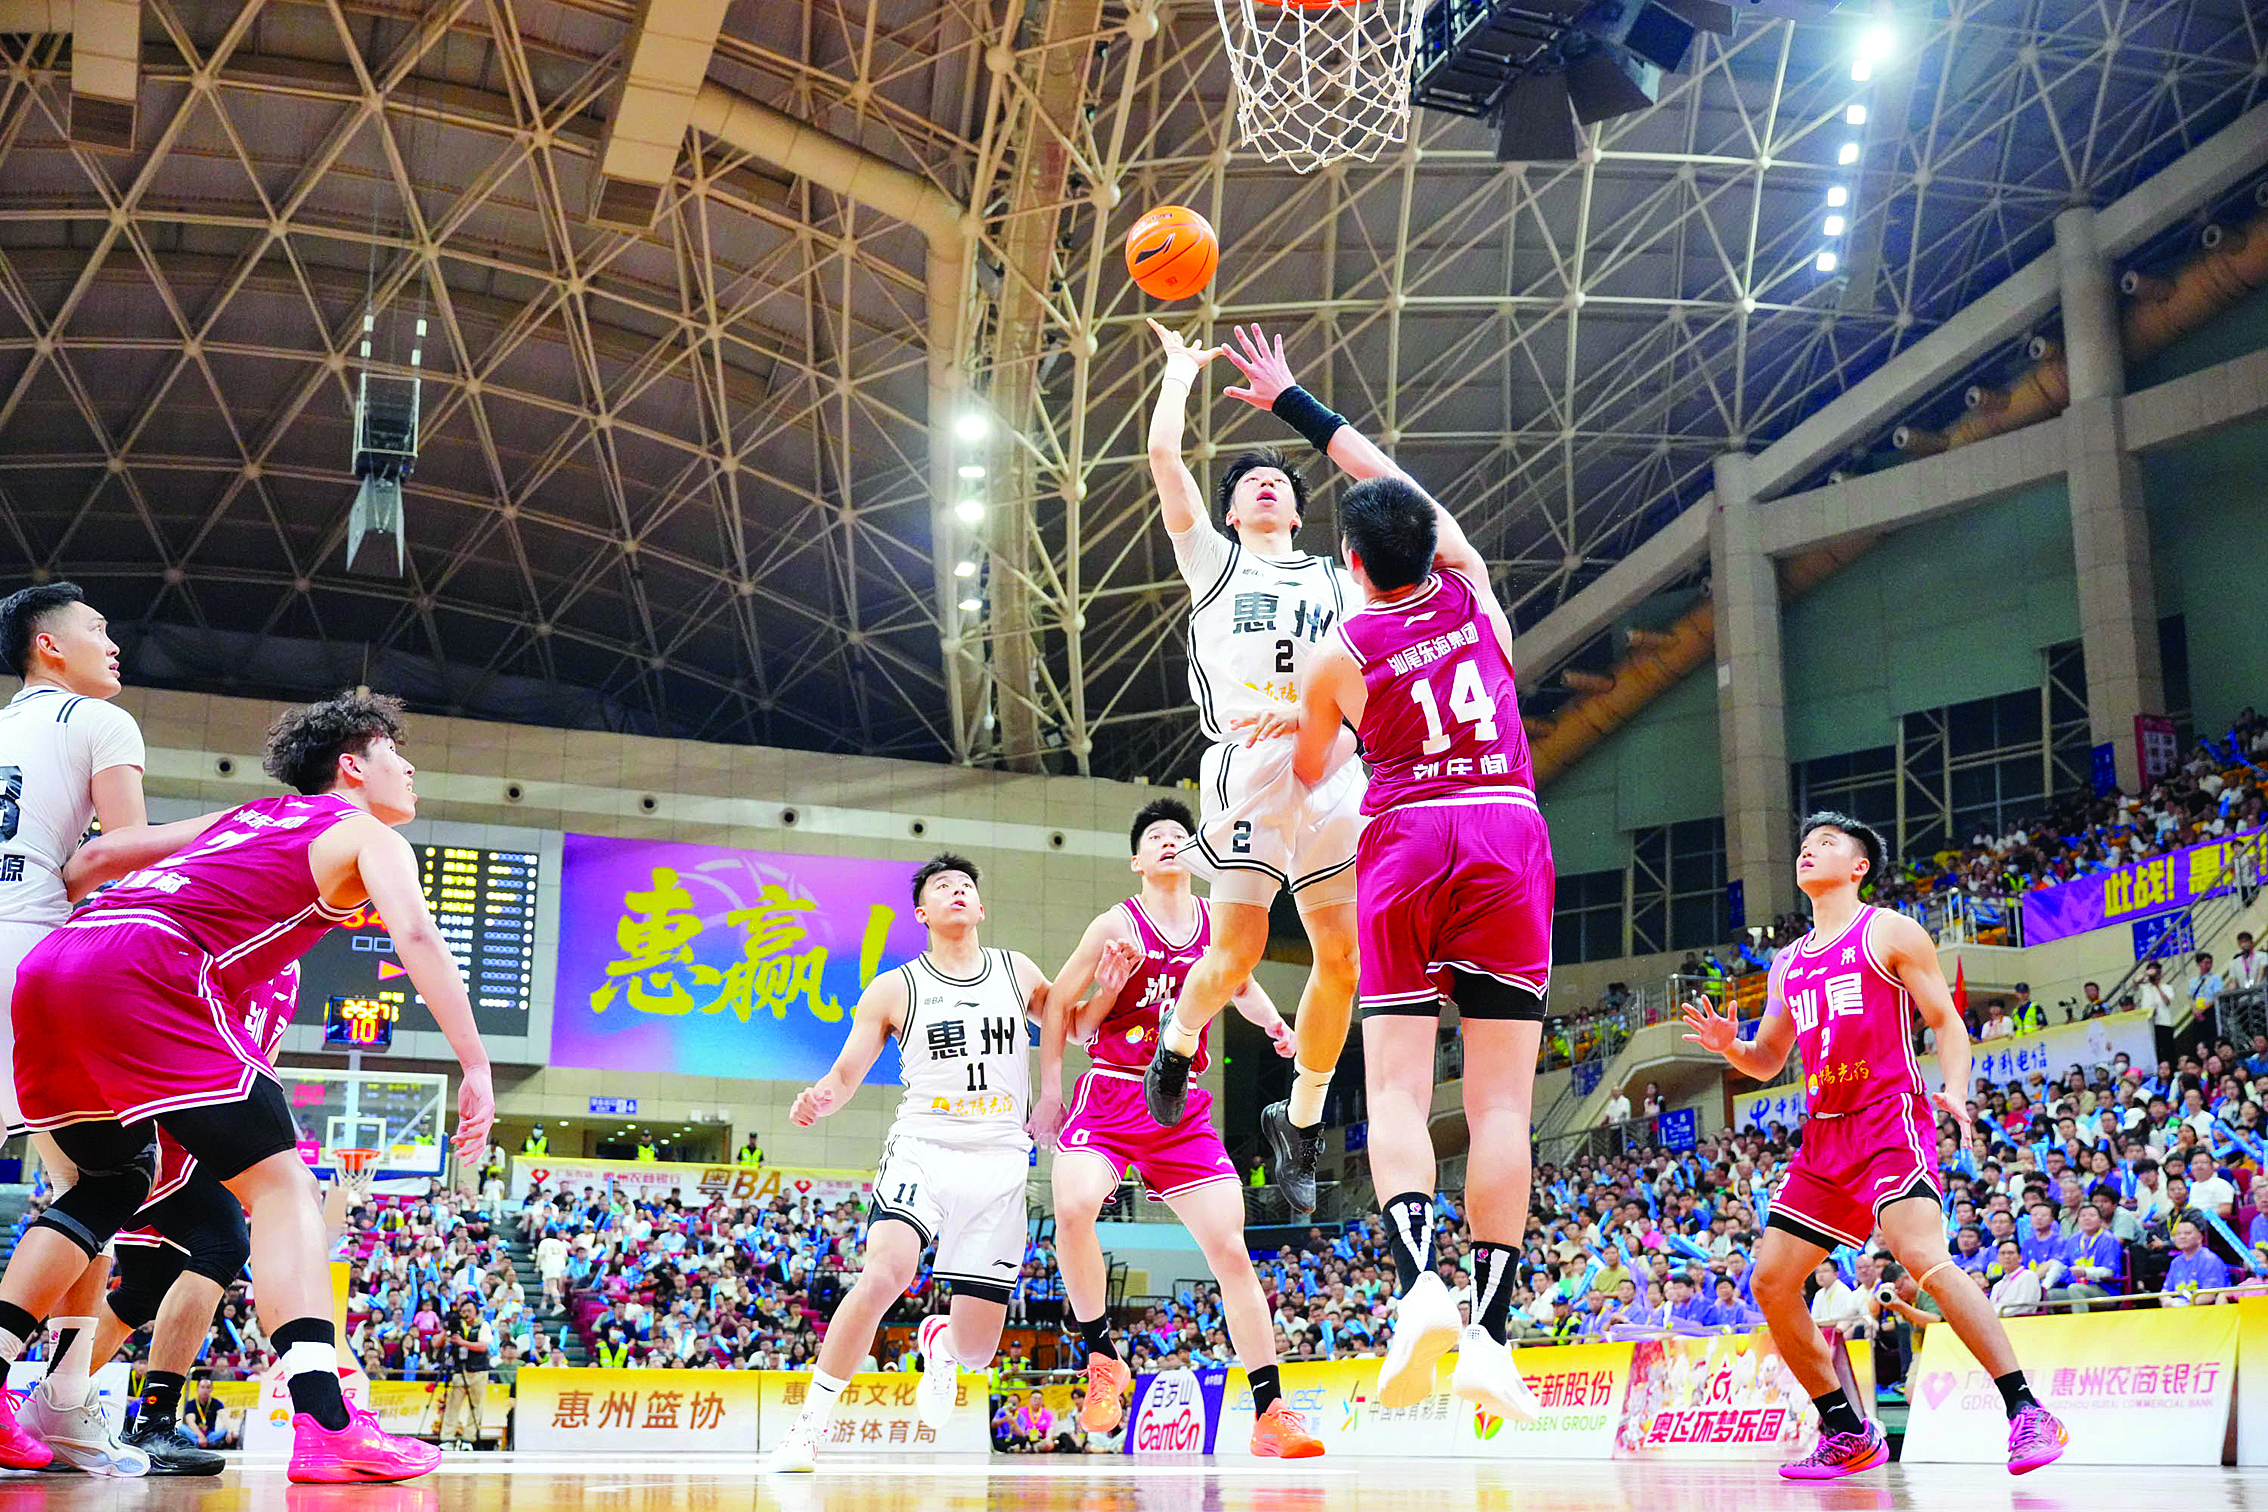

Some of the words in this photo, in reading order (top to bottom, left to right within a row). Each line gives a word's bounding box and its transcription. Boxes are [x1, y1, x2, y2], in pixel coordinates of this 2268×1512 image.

[1233, 592, 1334, 643] 惠州
[1276, 640, 1293, 673] 2
[1386, 621, 1480, 677] 汕尾东海集团
[1410, 659, 1499, 755] 14
[1232, 821, 1251, 853] 2
[1788, 972, 1864, 1036] 汕尾
[351, 1018, 376, 1042] 10
[926, 1017, 1015, 1060] 惠州
[1820, 1027, 1831, 1060] 2
[966, 1062, 988, 1091] 11
[1071, 1128, 1091, 1145] 0
[893, 1183, 918, 1207] 11
[1153, 1378, 1194, 1408] 百岁山
[2051, 1362, 2221, 1397] 惠州农商银行
[552, 1390, 727, 1429] 惠州篮协
[1561, 1415, 1608, 1432] GROUP
[1648, 1407, 1787, 1444] 奥飞环梦乐园
[827, 1418, 937, 1444] 游体育局
